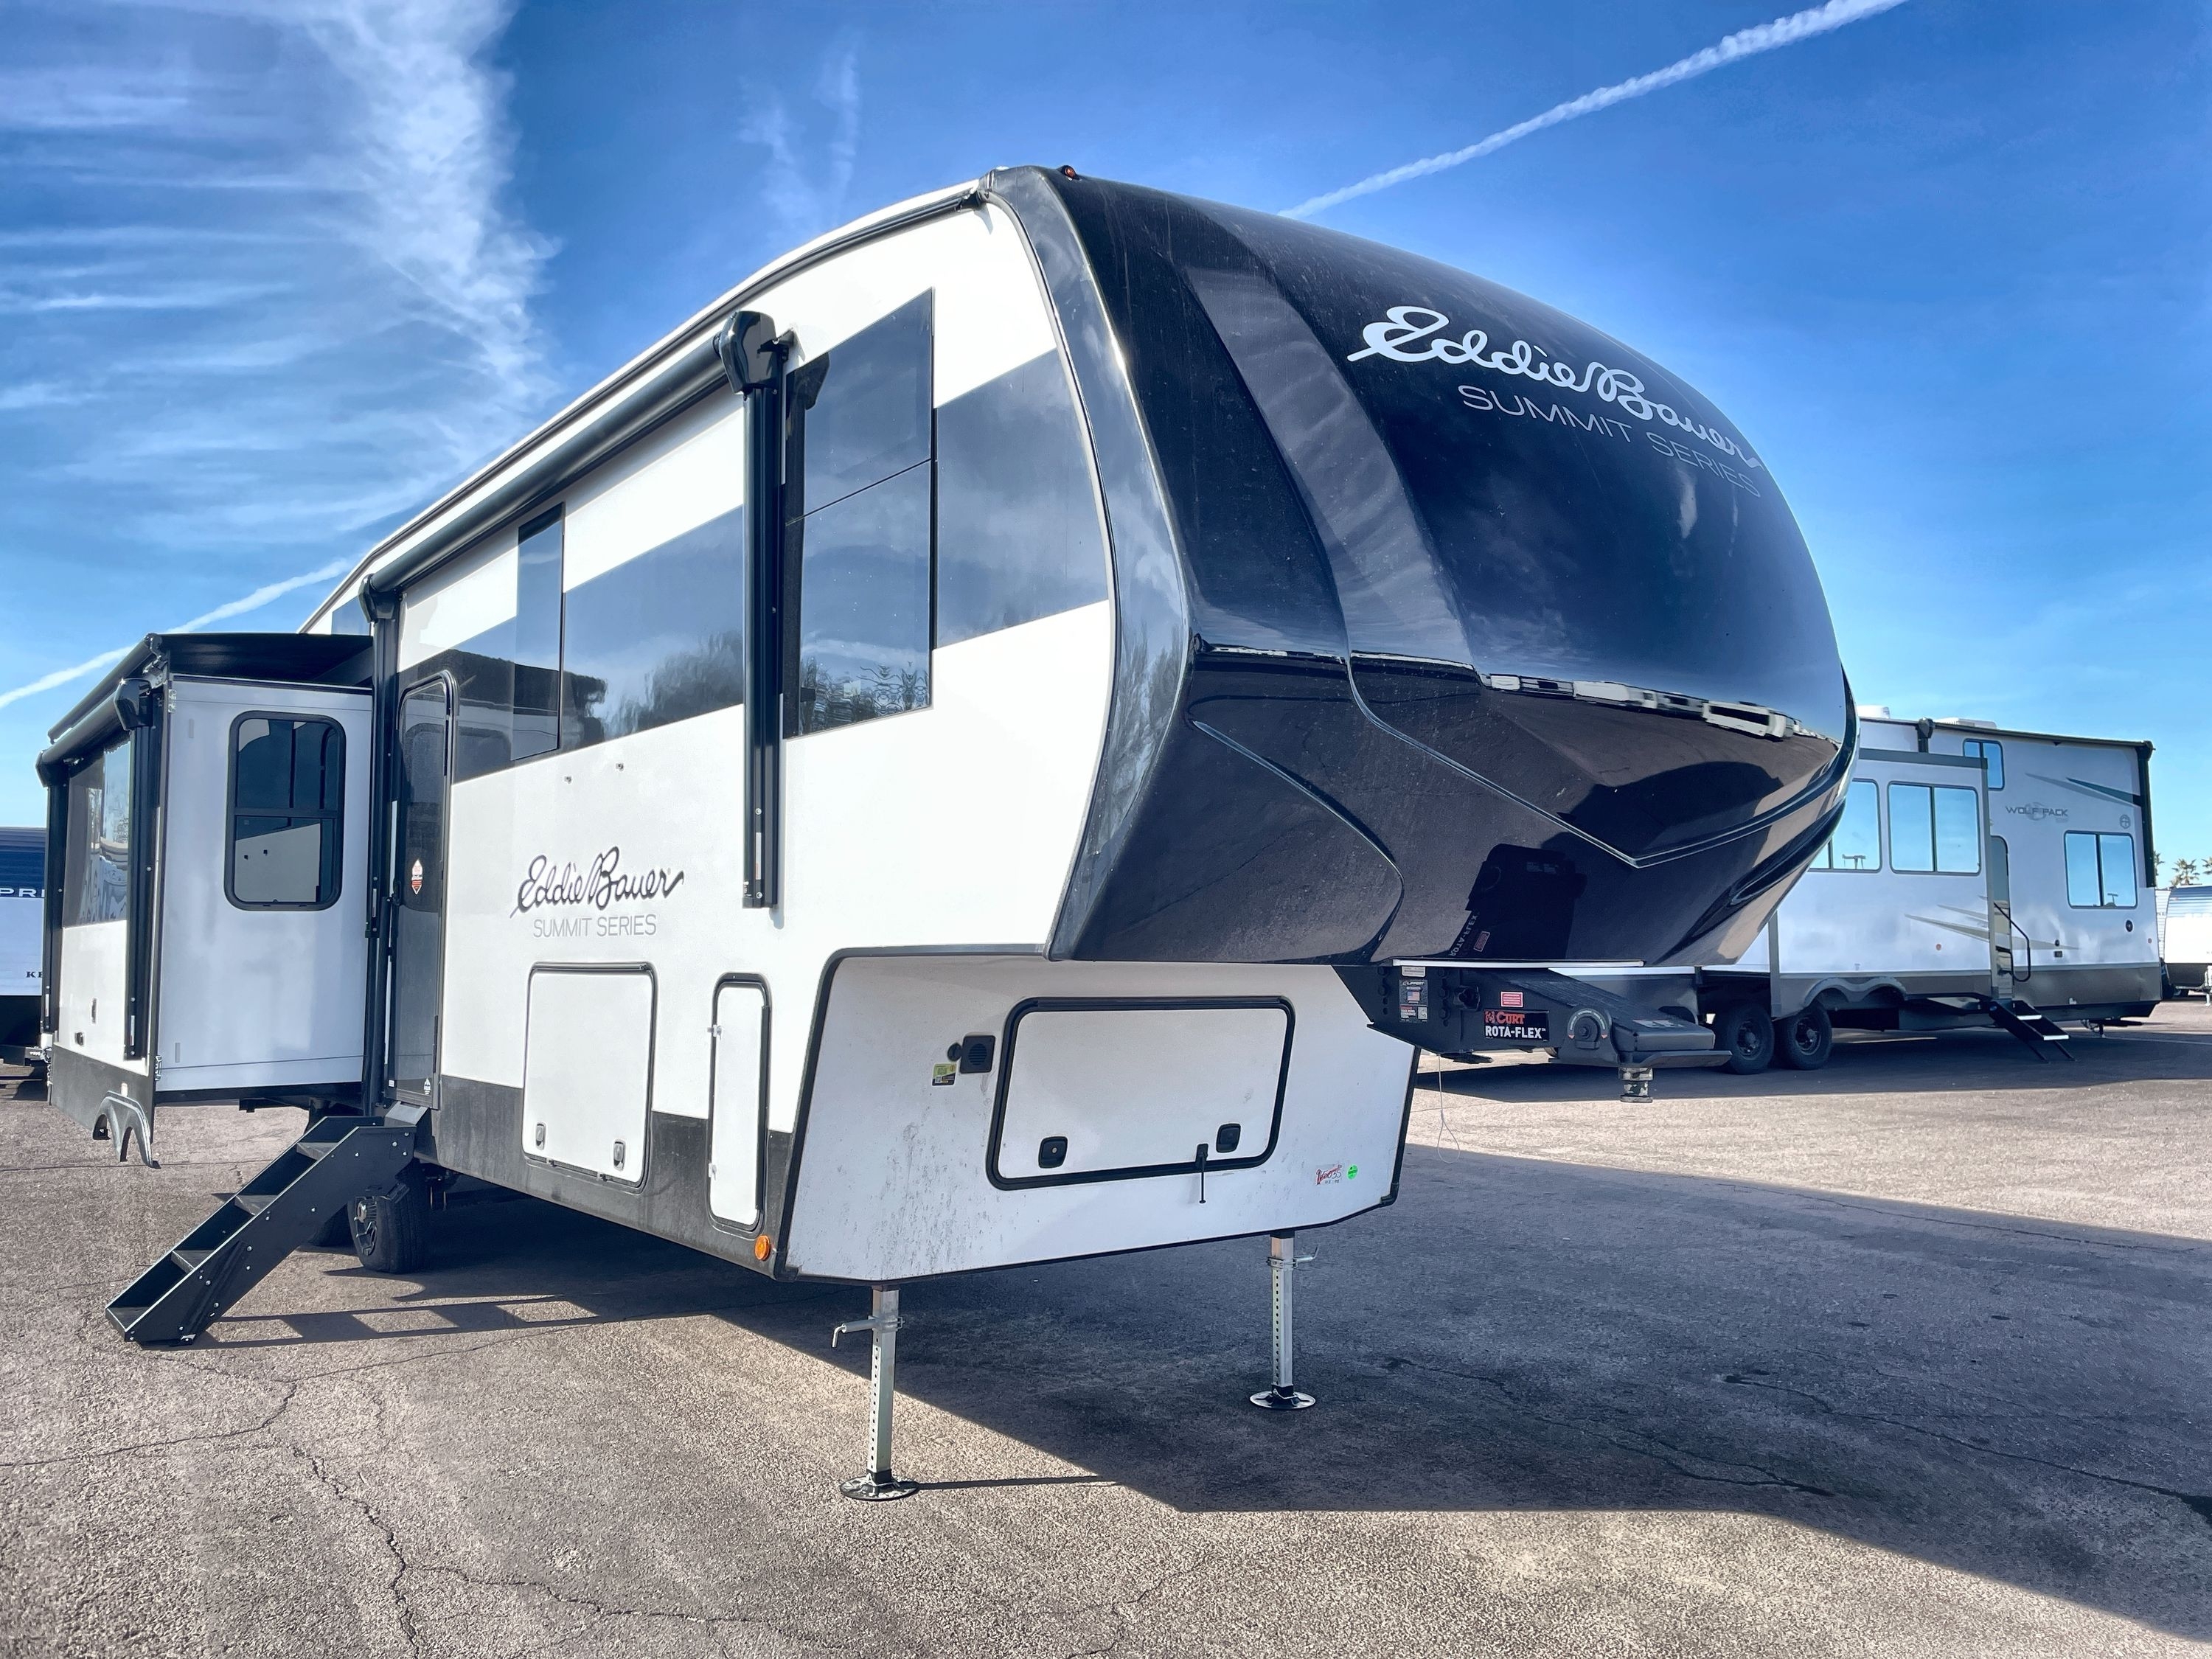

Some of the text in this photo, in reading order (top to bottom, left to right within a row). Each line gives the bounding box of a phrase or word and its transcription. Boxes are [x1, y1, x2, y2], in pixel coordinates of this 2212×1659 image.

[1458, 385, 1761, 498] SUMMIT SERIES
[2006, 806, 2068, 817] WOLF PACK
[533, 914, 657, 937] SUMMIT SERIES
[1496, 1011, 1526, 1024] CURT
[1485, 1025, 1543, 1039] ROTA-FLEX
